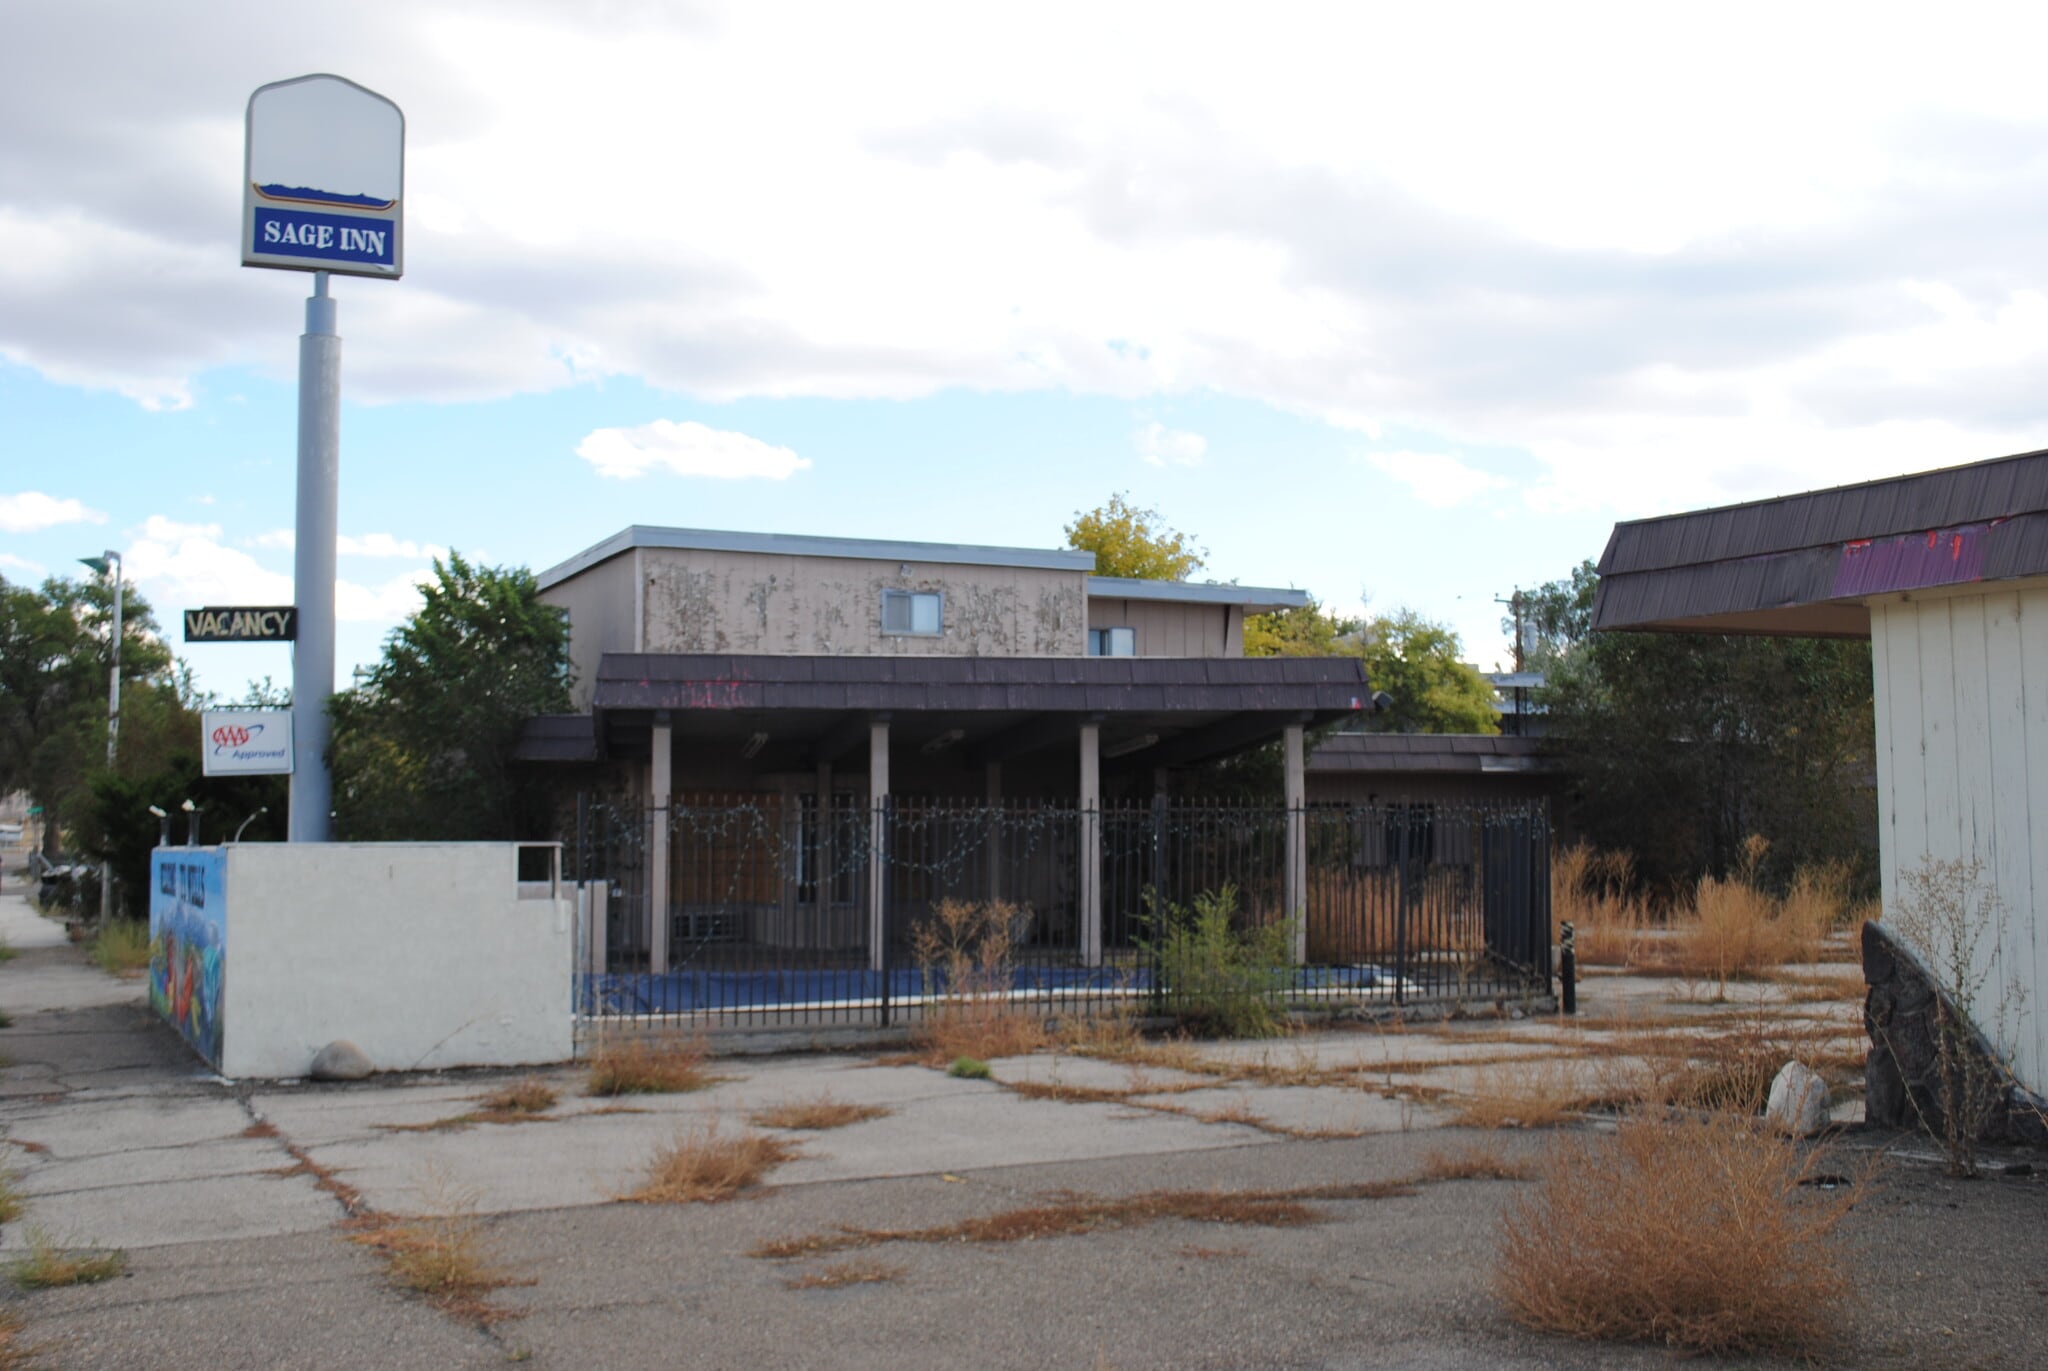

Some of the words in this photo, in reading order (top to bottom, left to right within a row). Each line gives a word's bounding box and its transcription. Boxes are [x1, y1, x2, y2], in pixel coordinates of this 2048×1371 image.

[264, 220, 334, 249] SAGE
[340, 227, 386, 257] INN
[187, 611, 291, 637] VACANCY
[213, 726, 249, 747] AAA
[233, 748, 285, 760] Approved
